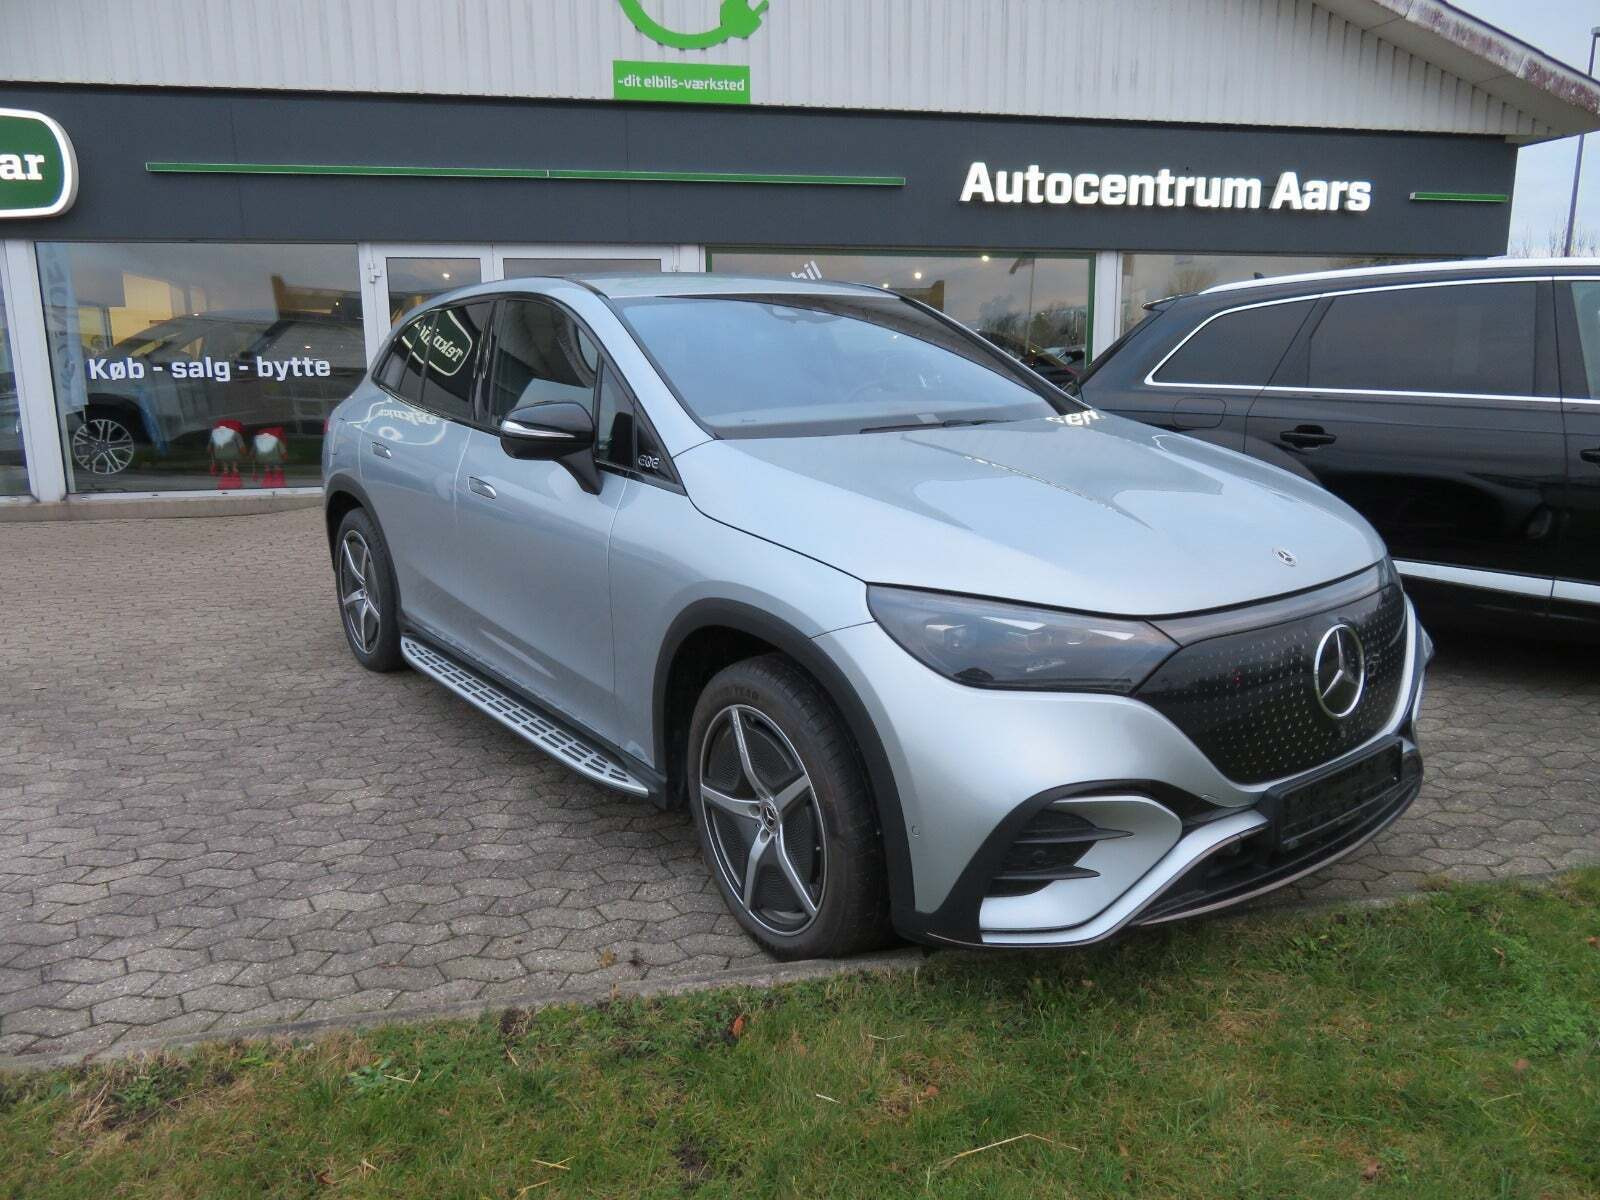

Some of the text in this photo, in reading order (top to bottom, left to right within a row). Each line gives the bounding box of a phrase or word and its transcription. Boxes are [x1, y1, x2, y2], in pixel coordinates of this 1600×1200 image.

[617, 74, 746, 92] -dit elbils-værksted
[960, 161, 1373, 213] Autocentrum Aars
[87, 356, 145, 380] Køb
[170, 355, 232, 382] salg
[256, 355, 331, 382] bytte
